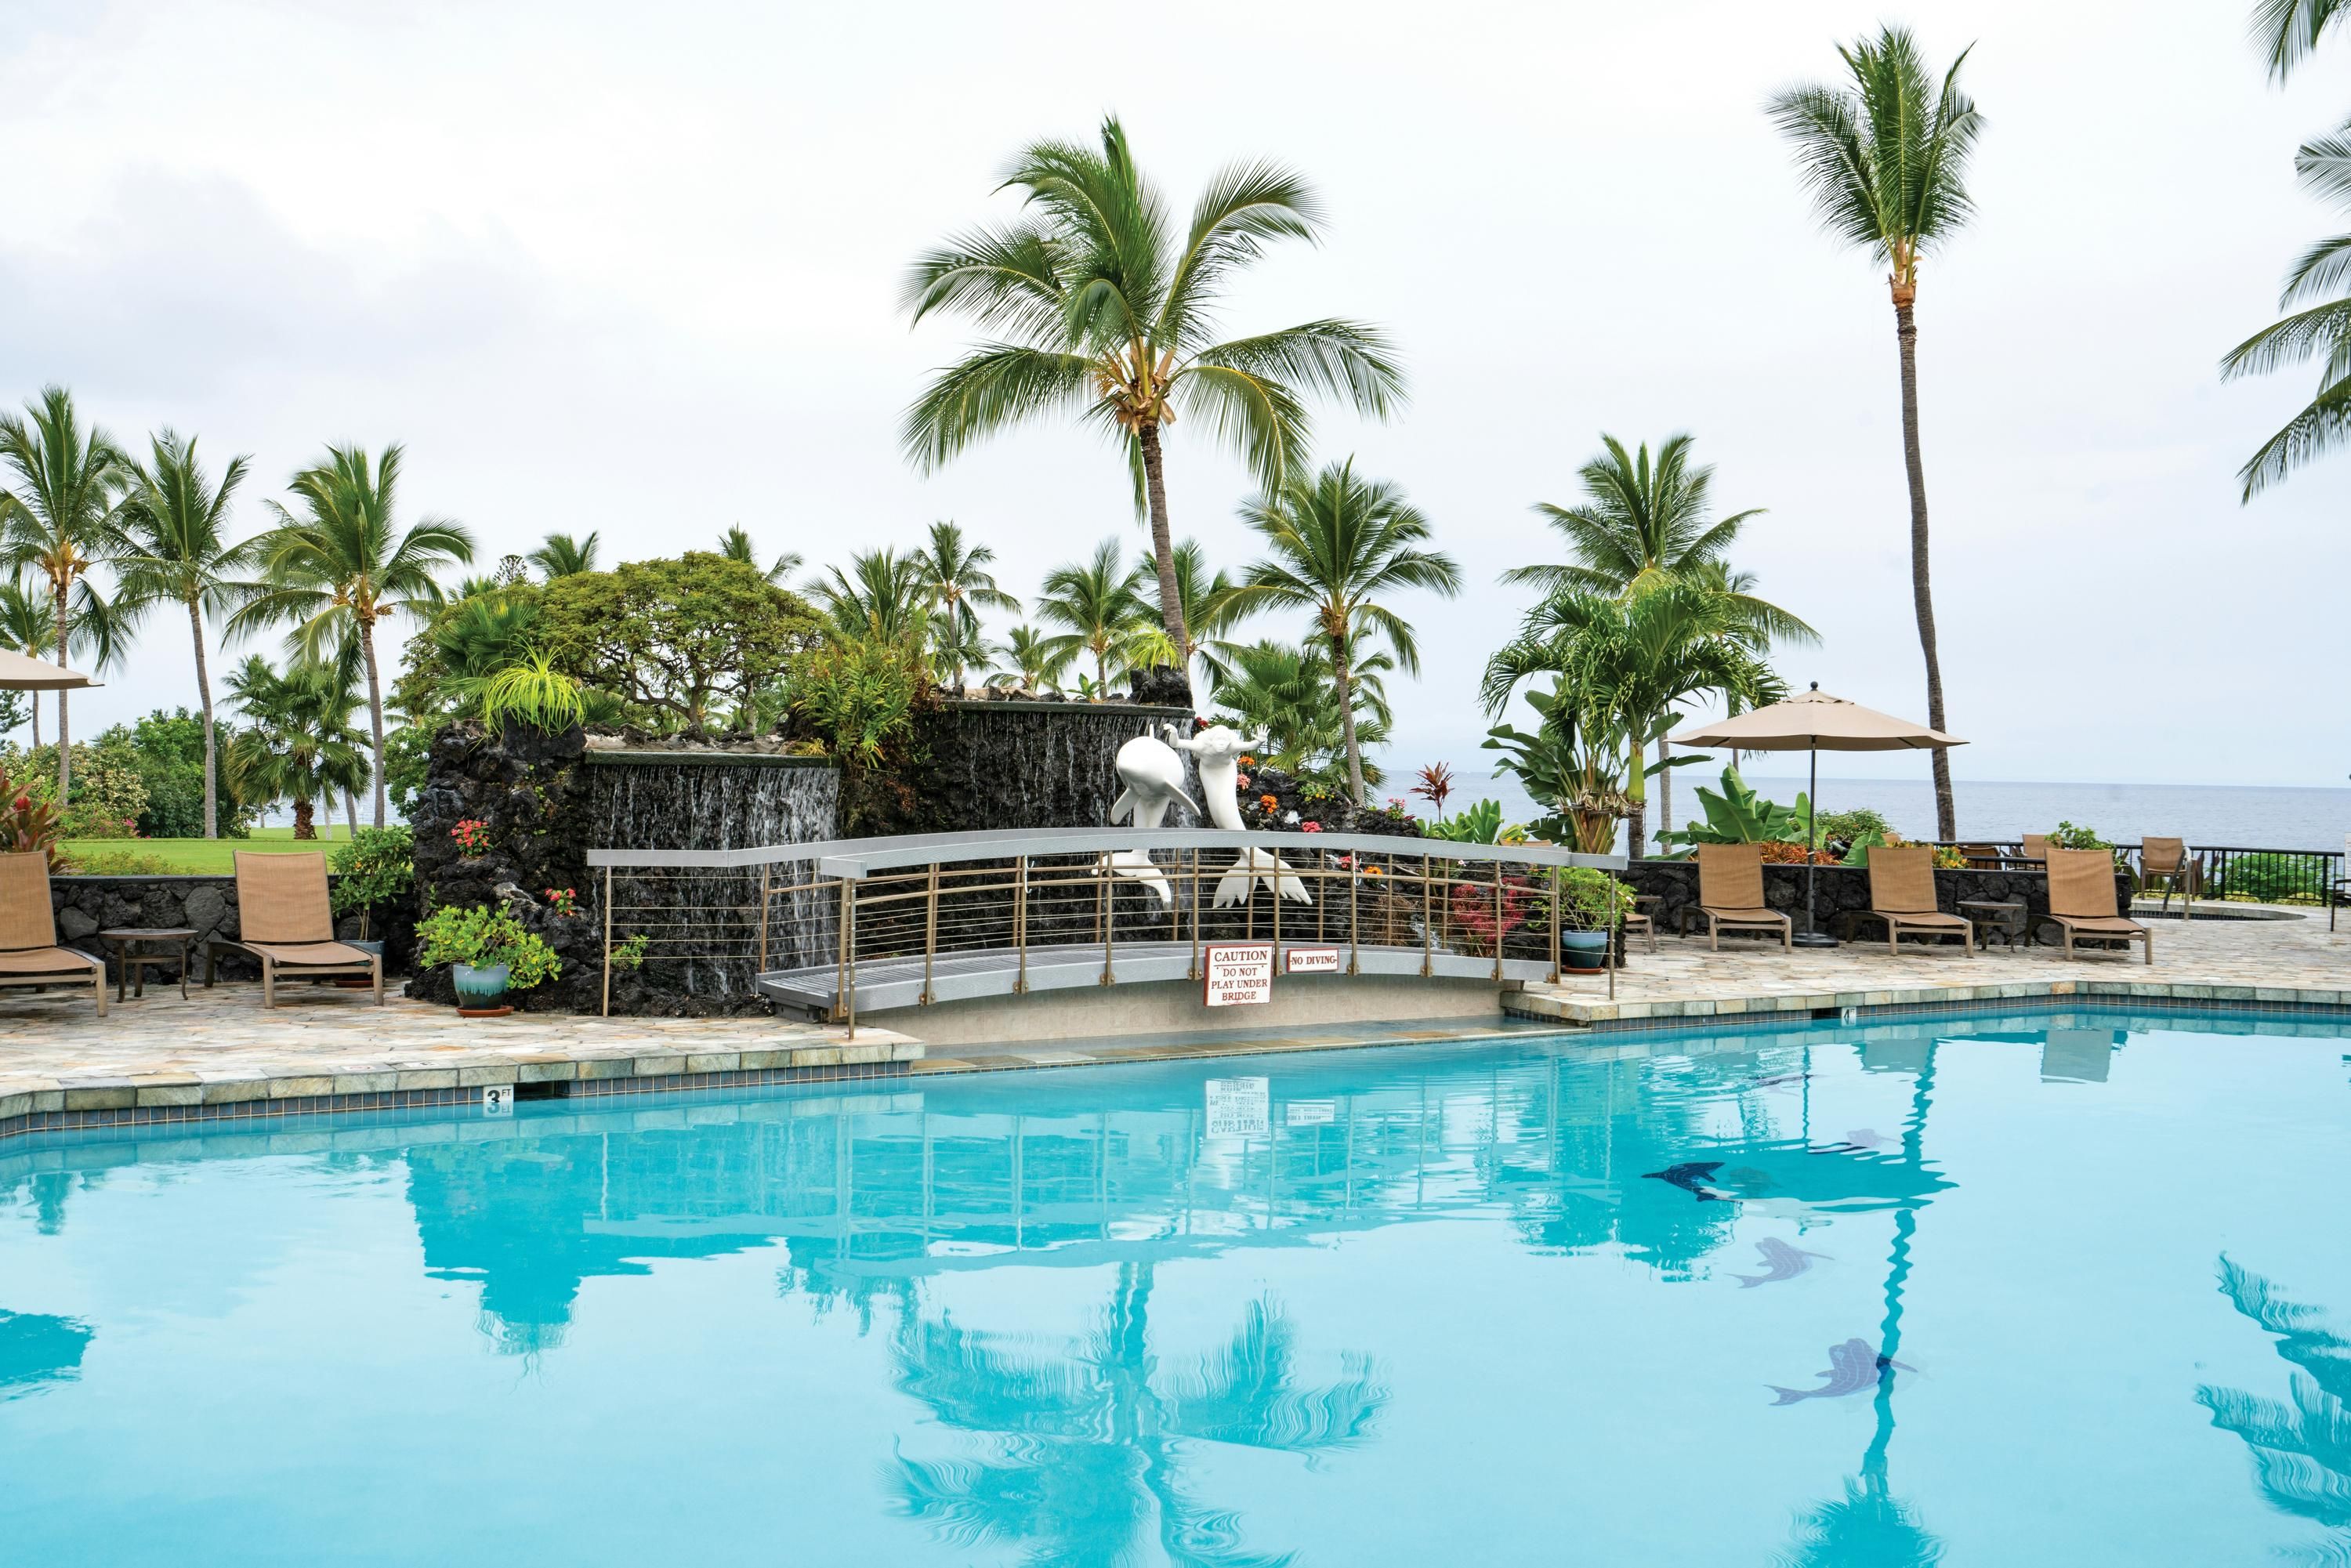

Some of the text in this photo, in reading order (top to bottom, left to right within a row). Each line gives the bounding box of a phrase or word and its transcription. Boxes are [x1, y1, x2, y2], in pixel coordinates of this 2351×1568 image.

[1214, 951, 1267, 961] CAUTION
[1291, 955, 1335, 965] NO DIVING
[1223, 967, 1258, 977] DO NOT
[1211, 979, 1268, 989] PLAY UNDER
[1222, 991, 1257, 1001] BRIDGE
